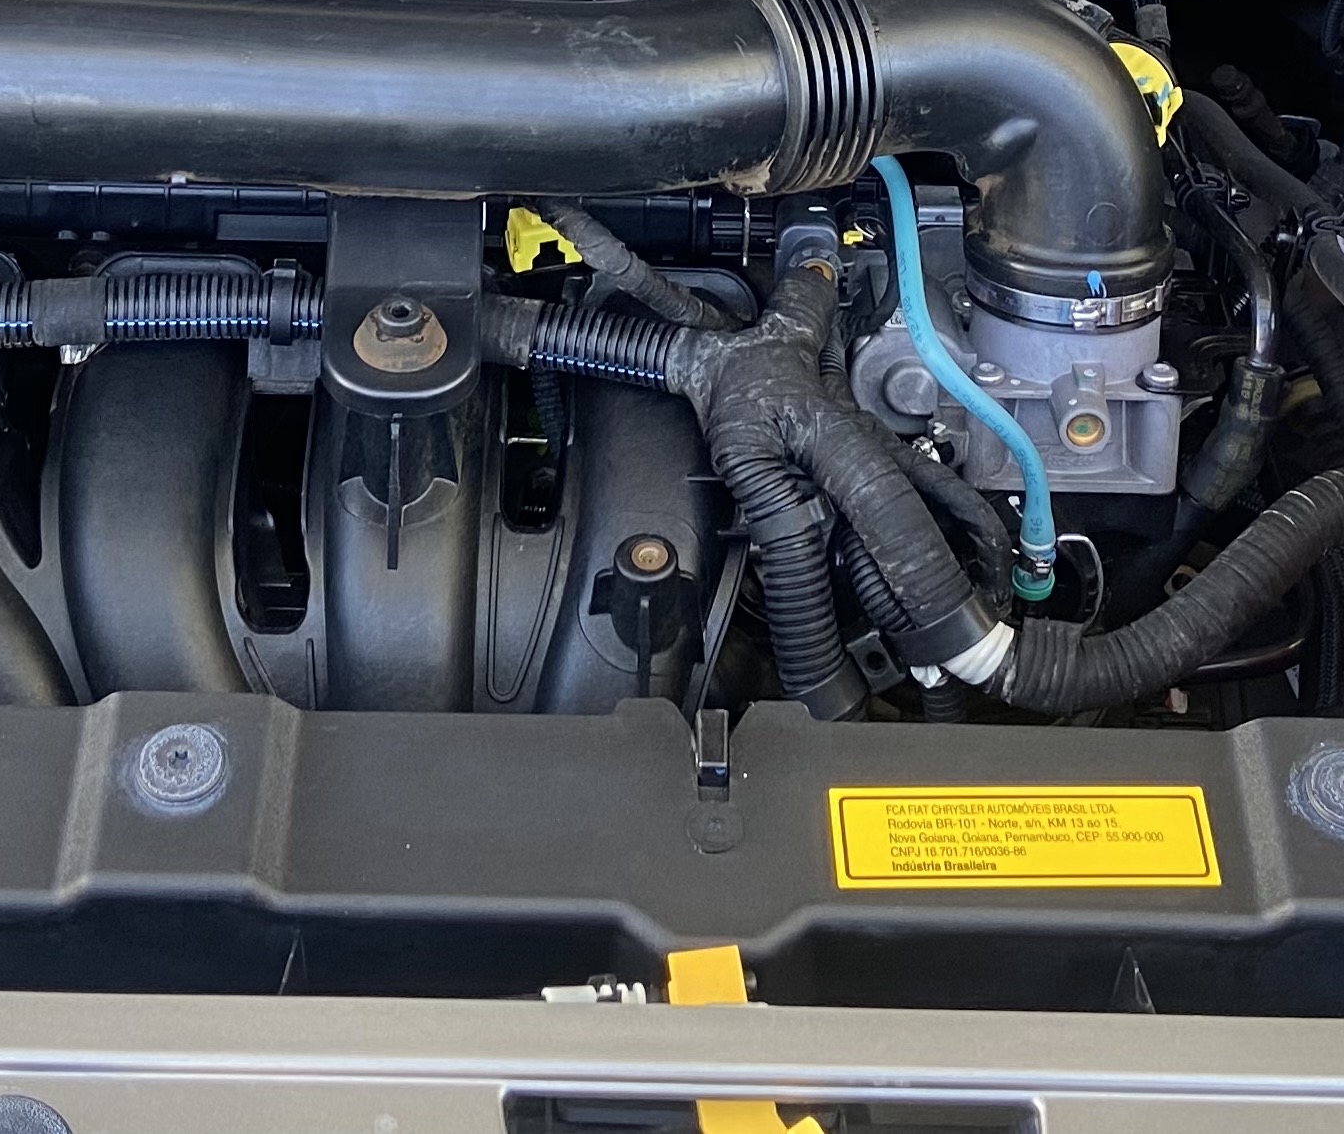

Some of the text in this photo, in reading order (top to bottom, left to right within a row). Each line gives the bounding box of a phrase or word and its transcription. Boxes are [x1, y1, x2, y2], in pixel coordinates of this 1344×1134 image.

[886, 804, 906, 815] FCA
[908, 804, 929, 815] FIAT
[931, 803, 985, 815] CHRYSLER
[987, 802, 1051, 815] AUTOMÓVEIS
[1053, 803, 1088, 814] BRASIL
[887, 818, 933, 829] Rodovia
[935, 818, 977, 829] BR-101
[988, 818, 1022, 830] Norte,
[1048, 818, 1066, 828] KM
[1071, 818, 1084, 828] 13
[1087, 819, 1101, 828] ao
[889, 832, 916, 843] Nova
[919, 832, 959, 844] Goiana,
[962, 832, 1002, 844] Goiana,
[1005, 831, 1074, 843] Pernambuco,
[890, 846, 921, 857] CNPJ
[892, 859, 997, 872] Indústria Brasileira
